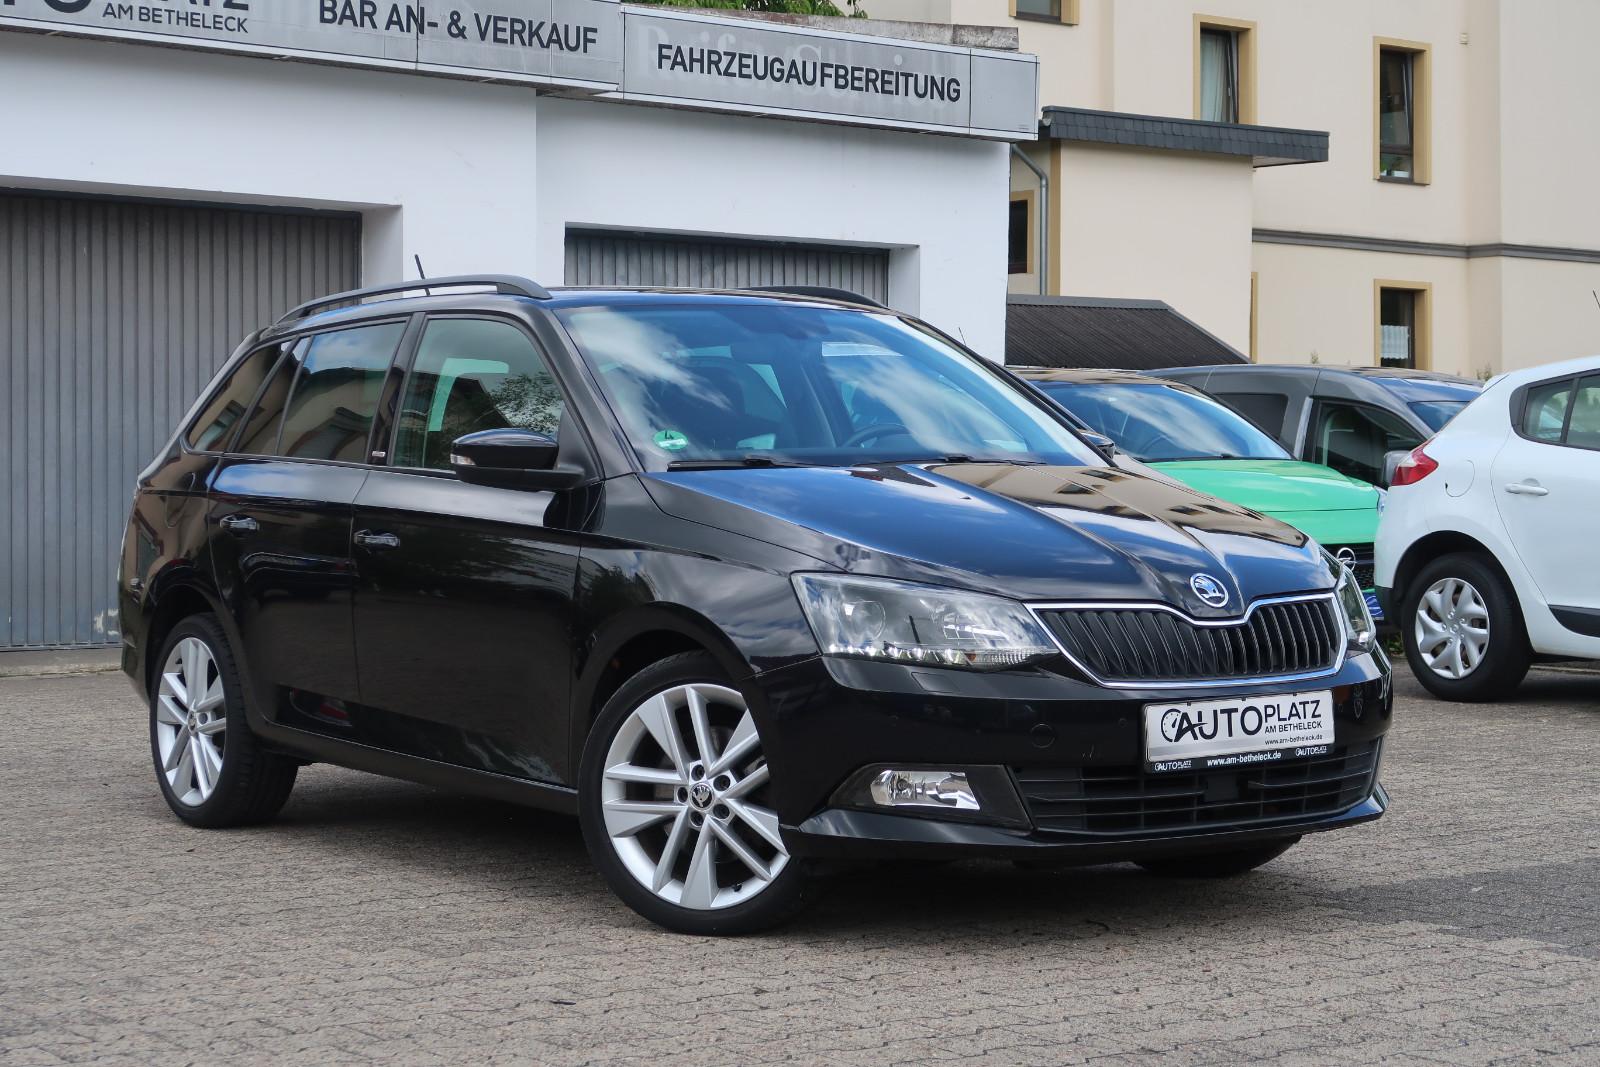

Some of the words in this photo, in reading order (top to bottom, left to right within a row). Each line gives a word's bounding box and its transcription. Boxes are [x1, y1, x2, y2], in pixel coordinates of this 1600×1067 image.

[102, 3, 134, 21] AM
[138, 6, 249, 34] BETHELECK
[319, 0, 378, 30] BAR
[473, 13, 599, 54] VERKAUF
[656, 43, 962, 103] FAHRZEUGAUFBEREITUNG
[1264, 725, 1277, 735] AM
[1278, 720, 1323, 734] BETHELECK
[1264, 734, 1323, 746] www.am-betheleck.de
[1206, 751, 1282, 767] www.am-betheleck.de
